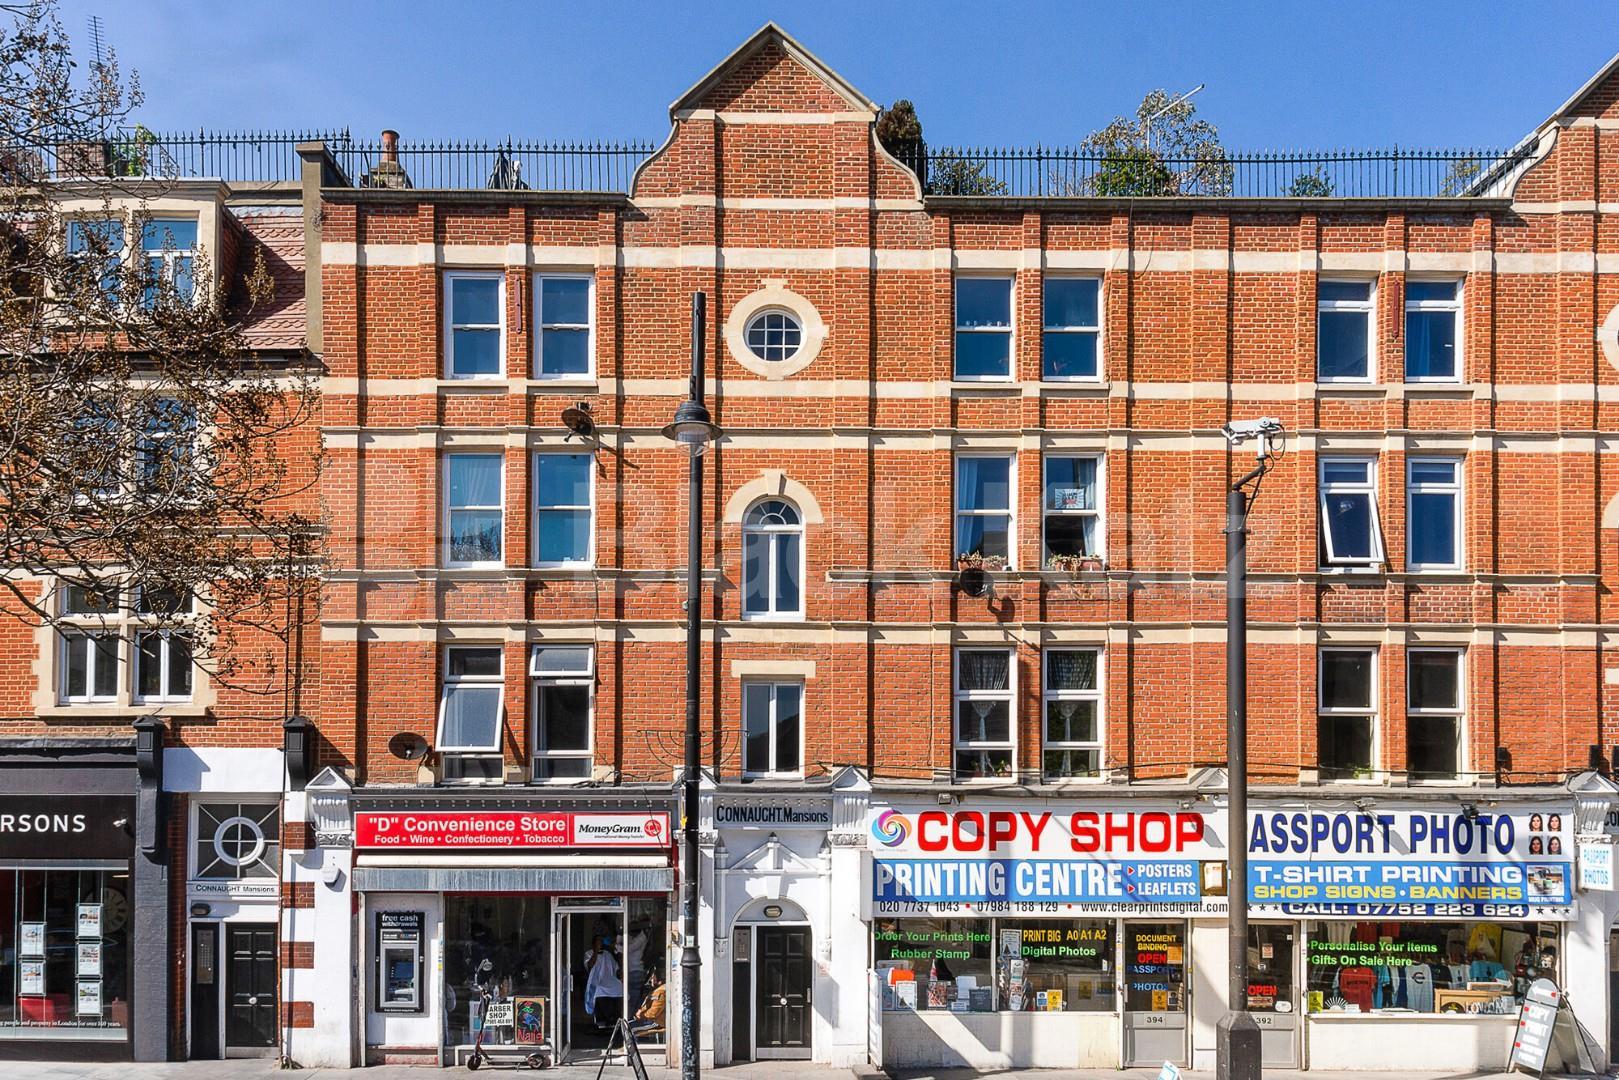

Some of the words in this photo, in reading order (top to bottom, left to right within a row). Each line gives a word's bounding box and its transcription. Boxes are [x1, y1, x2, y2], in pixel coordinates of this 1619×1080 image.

[783, 807, 829, 823] Mansions
[0, 814, 86, 833] RSONS
[369, 817, 399, 832] "D"
[403, 817, 516, 832] Convenience
[520, 817, 566, 832] Store
[578, 823, 641, 836] MoneyGram
[917, 811, 1053, 852] COPY
[1070, 811, 1205, 853] SHOP
[1248, 813, 1396, 854] ASSPORT
[1409, 814, 1515, 855] PHOTO
[374, 834, 400, 844] Food
[409, 834, 435, 844] Wine
[444, 834, 514, 846] Confectionery
[523, 834, 565, 844] Tobacco
[1137, 864, 1193, 878] POSTERS
[1254, 865, 1372, 883] T-SHIRT
[1381, 865, 1522, 884] PRINTING
[876, 862, 1005, 896] PRINTING
[1015, 862, 1123, 897] CENTRE
[195, 884, 240, 892] CONNAUGHT
[1137, 882, 1197, 896] LEAFLETS
[1253, 885, 1318, 899] SHOP
[1325, 885, 1396, 899] SIGNS
[1409, 886, 1522, 900] BANNERS
[879, 901, 900, 912] 020
[904, 901, 930, 912] 7737
[935, 901, 960, 912] 1043
[977, 901, 1010, 912] 07984
[1015, 901, 1035, 912] 188
[1039, 901, 1058, 912] 129
[1288, 903, 1349, 914] CALL:
[1356, 903, 1427, 915] 07752
[1434, 903, 1475, 915] 223
[1483, 904, 1525, 916] 624
[400, 914, 417, 922] cash
[874, 932, 902, 941] Order
[906, 932, 930, 941] Your
[933, 932, 963, 941] Prints
[967, 932, 991, 942] Here
[1023, 929, 1045, 942] PRINT
[1047, 930, 1061, 942] BIG
[1080, 929, 1092, 940] A1
[1094, 929, 1107, 940] A2
[1136, 934, 1177, 942] DOCUMENT
[1022, 946, 1056, 958] Digital
[1059, 946, 1096, 956] Photos
[1137, 943, 1168, 951] BINDING
[1310, 940, 1376, 952] Personalise
[1380, 941, 1405, 952] Your
[891, 949, 932, 959] Rubber
[935, 949, 970, 960] Stamp
[1137, 953, 1167, 964] OPEN
[1311, 955, 1337, 965] Gifts
[1340, 955, 1356, 966] On
[1359, 955, 1384, 966] Sale
[1386, 956, 1413, 966] Here
[1247, 985, 1277, 995] OPEN
[57, 1019, 77, 1027] London
[1146, 1016, 1163, 1024] 394
[517, 1028, 543, 1041] Nails
